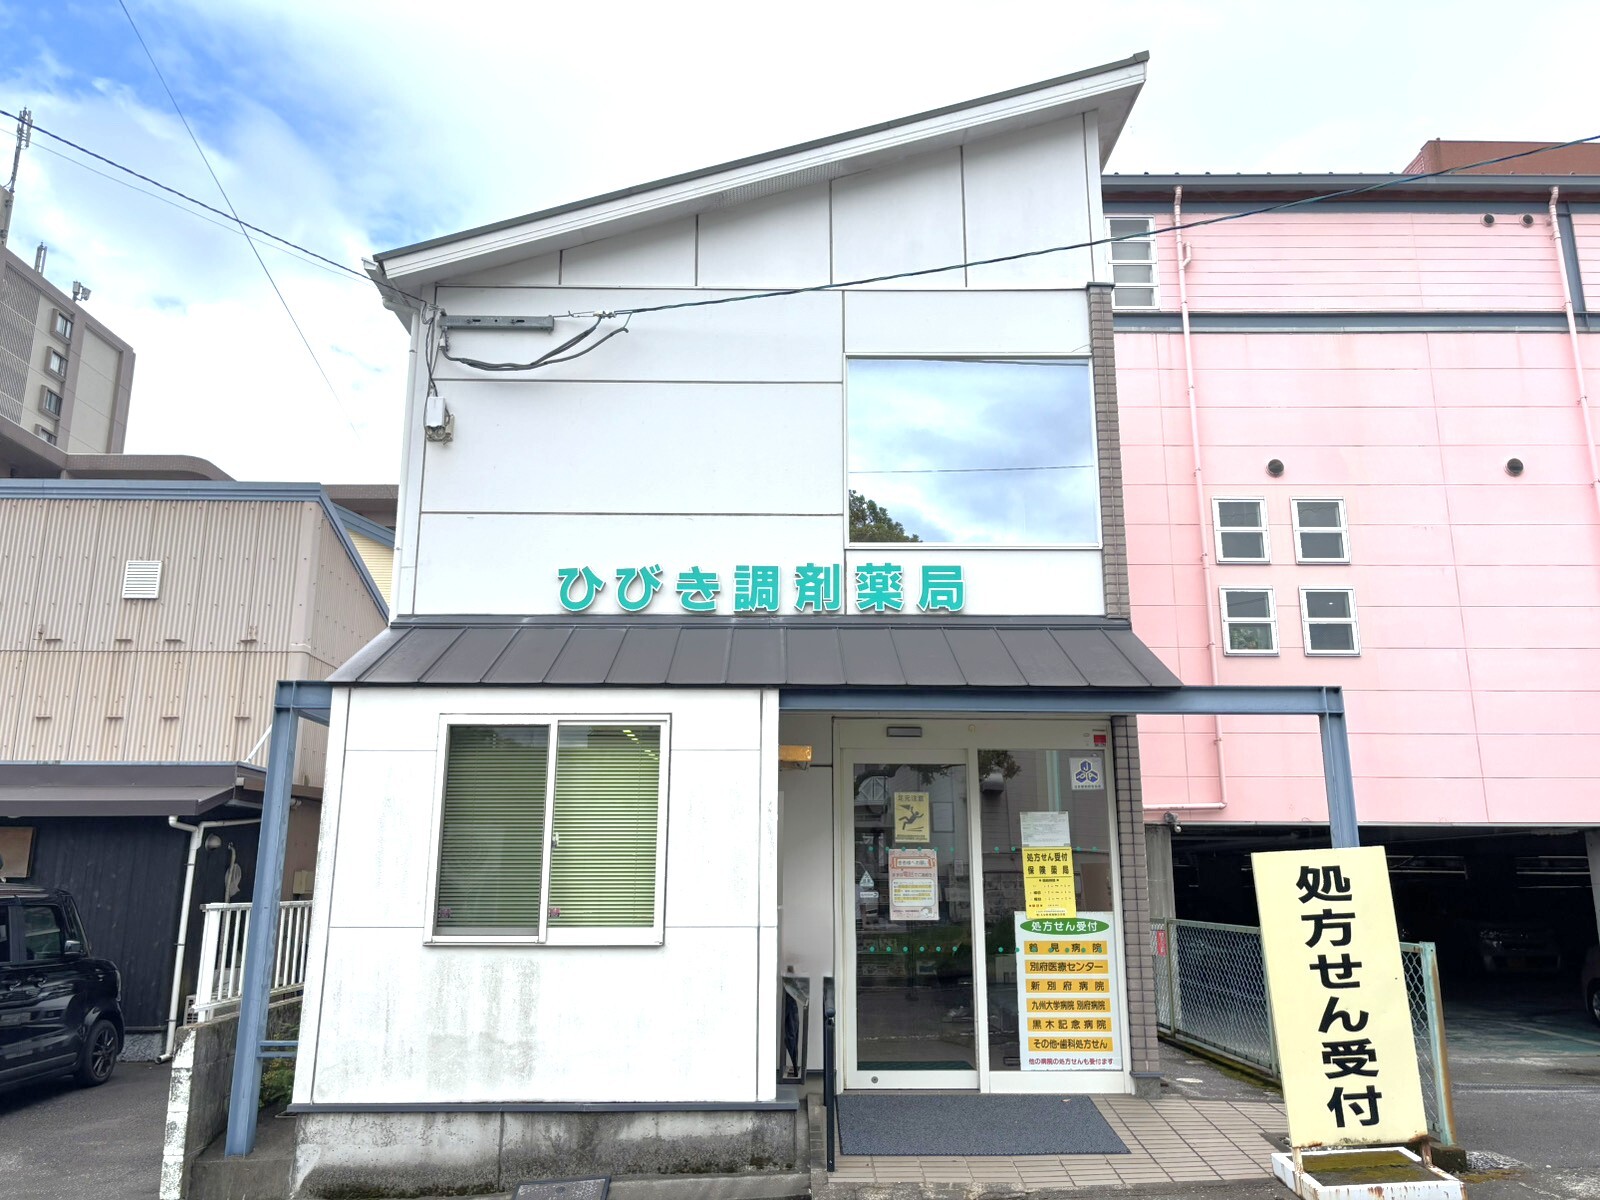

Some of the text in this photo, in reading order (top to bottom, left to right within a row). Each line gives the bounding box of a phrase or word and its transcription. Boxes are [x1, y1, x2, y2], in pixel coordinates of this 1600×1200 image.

[557, 562, 967, 614] ひびき調剤薬局
[1026, 852, 1068, 862] 処方せん受付
[1031, 921, 1098, 932] 処方せん受付
[1029, 962, 1104, 972] 別府医療センター
[1030, 981, 1105, 991] 新別府病院
[1296, 864, 1383, 1129] 処方せん受付
[1031, 1000, 1106, 1010] 九州大学病院 別府病院
[1032, 1019, 1107, 1030] 黒木記念病院
[1028, 1057, 1114, 1065] 他の病院の処方せんも受付ます
